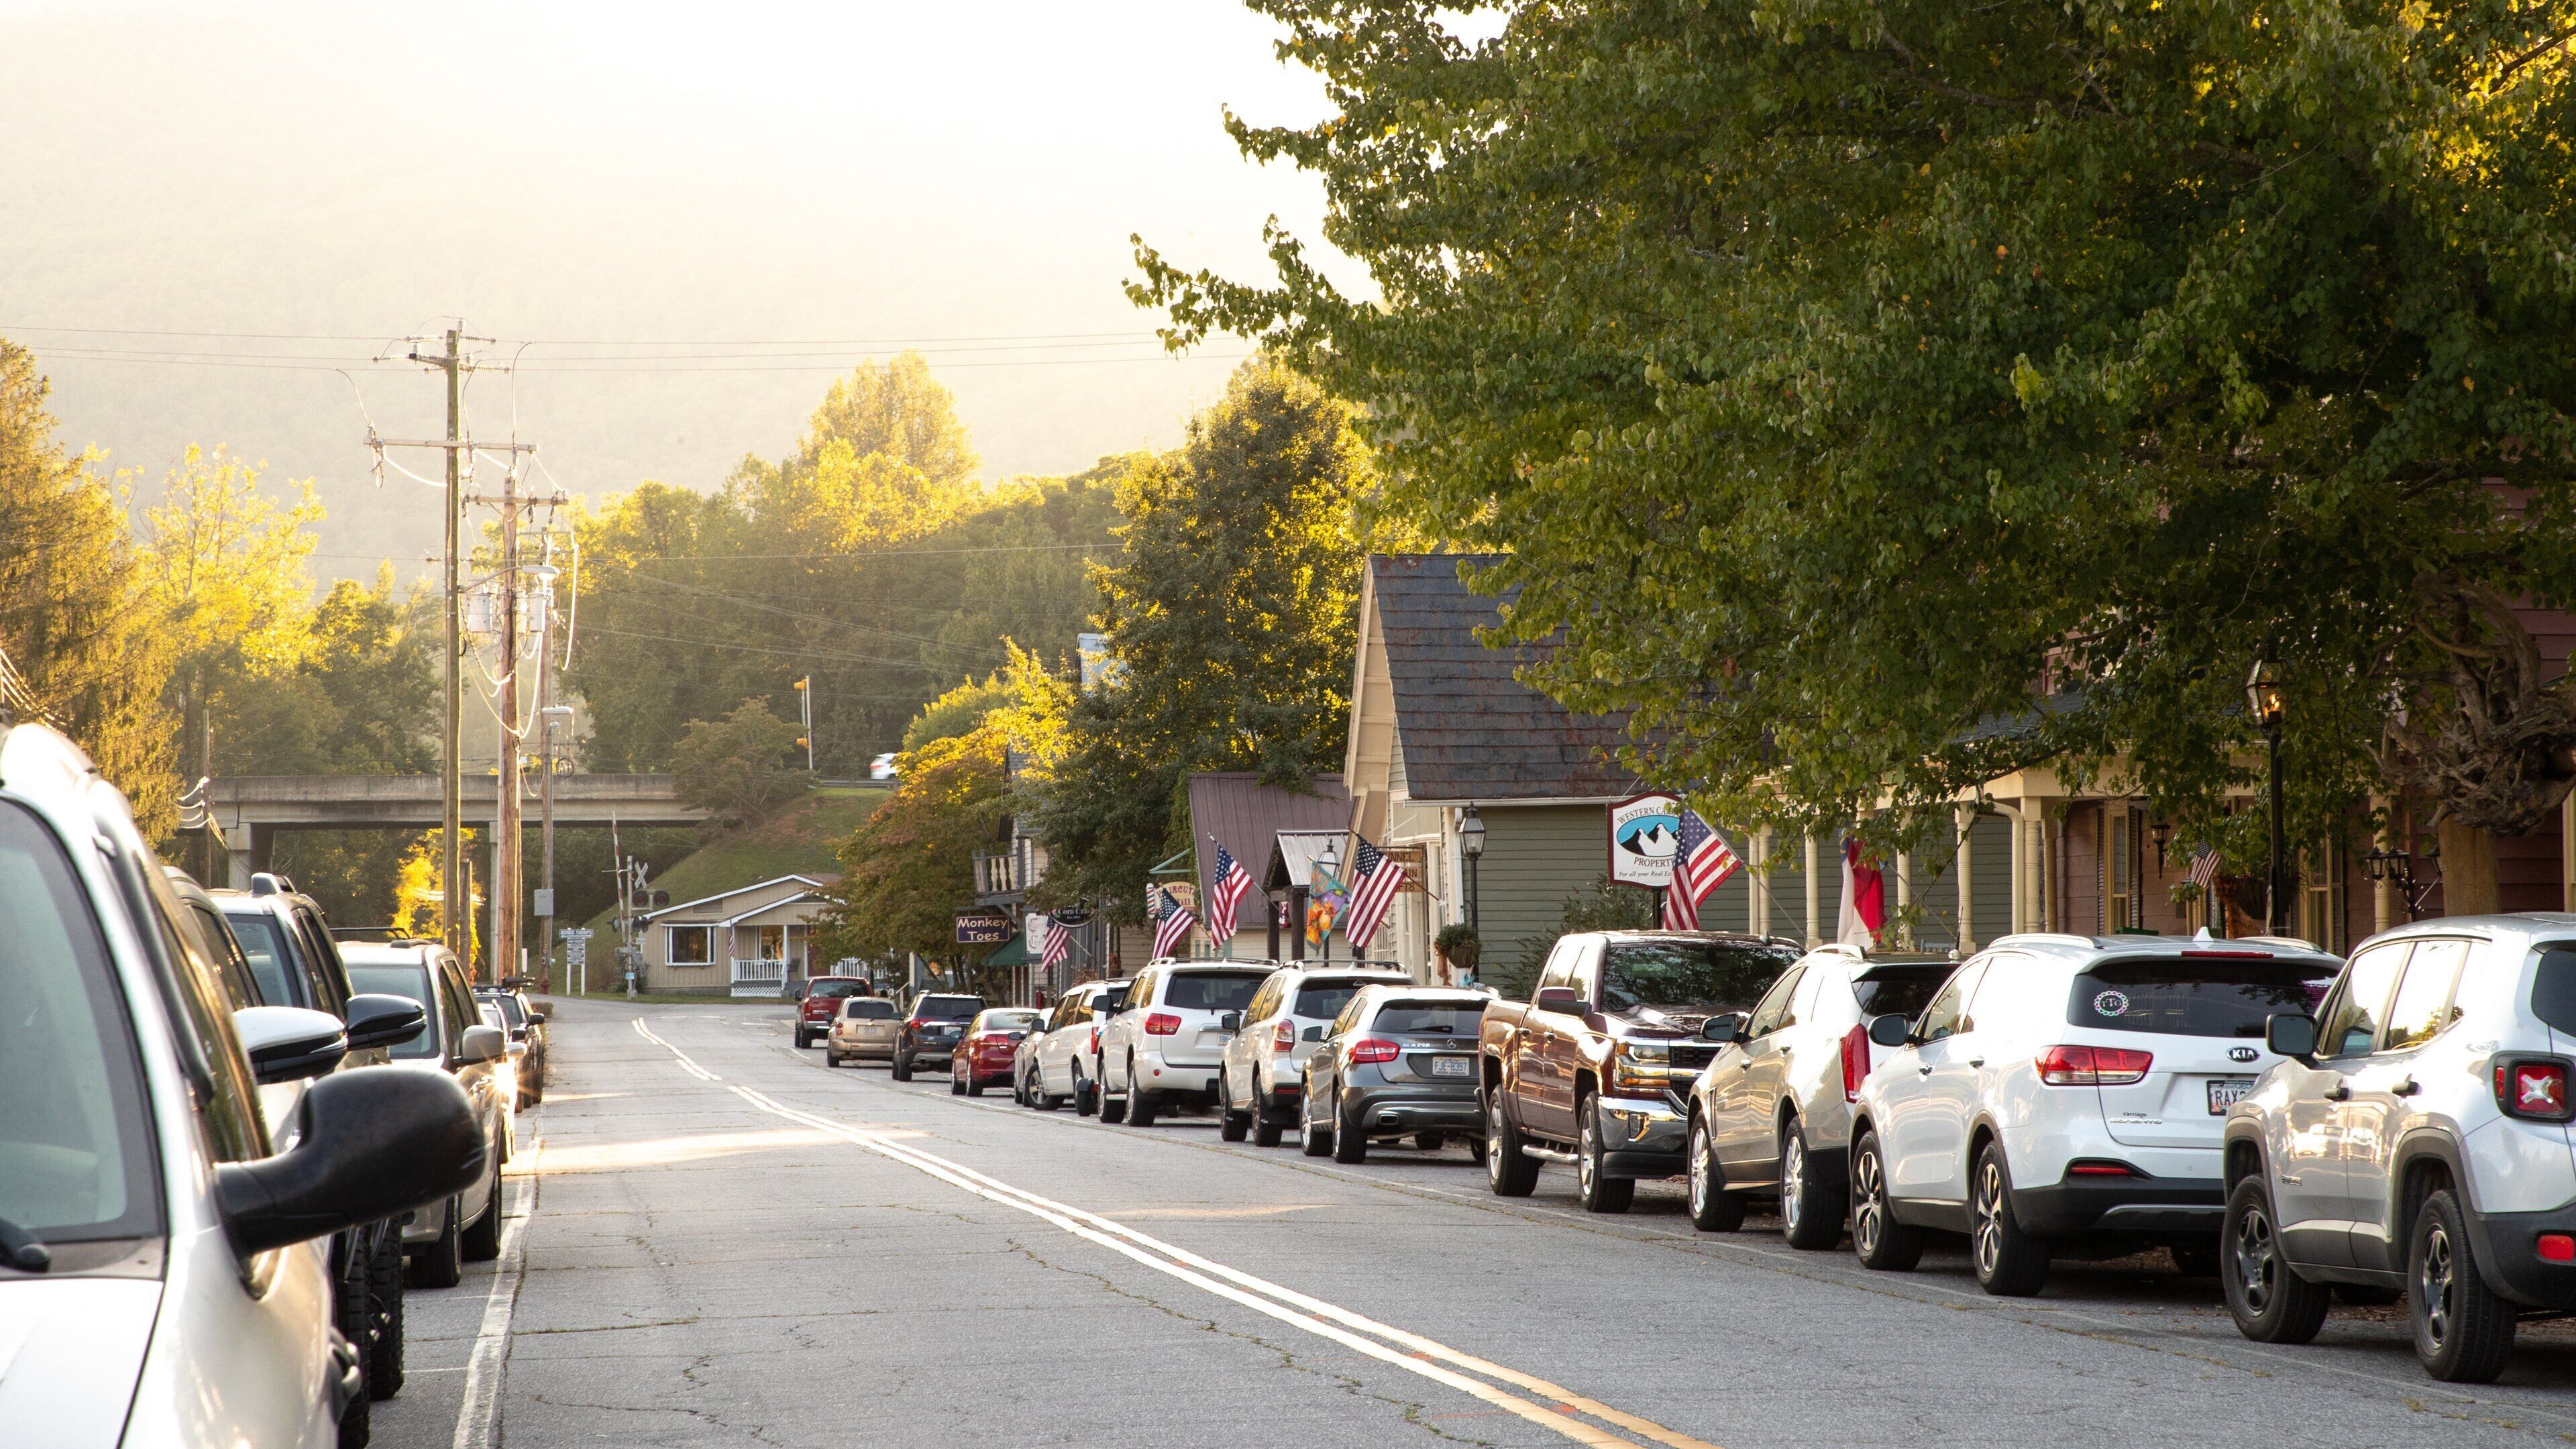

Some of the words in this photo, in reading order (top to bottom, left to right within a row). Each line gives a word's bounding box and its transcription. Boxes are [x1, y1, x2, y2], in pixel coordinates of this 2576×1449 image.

[1617, 806, 1654, 824] WESTERN
[1633, 857, 1674, 867] PROPERTI
[958, 917, 1008, 929] Monkey
[967, 931, 999, 941] Toes
[2232, 1049, 2255, 1059] KIA
